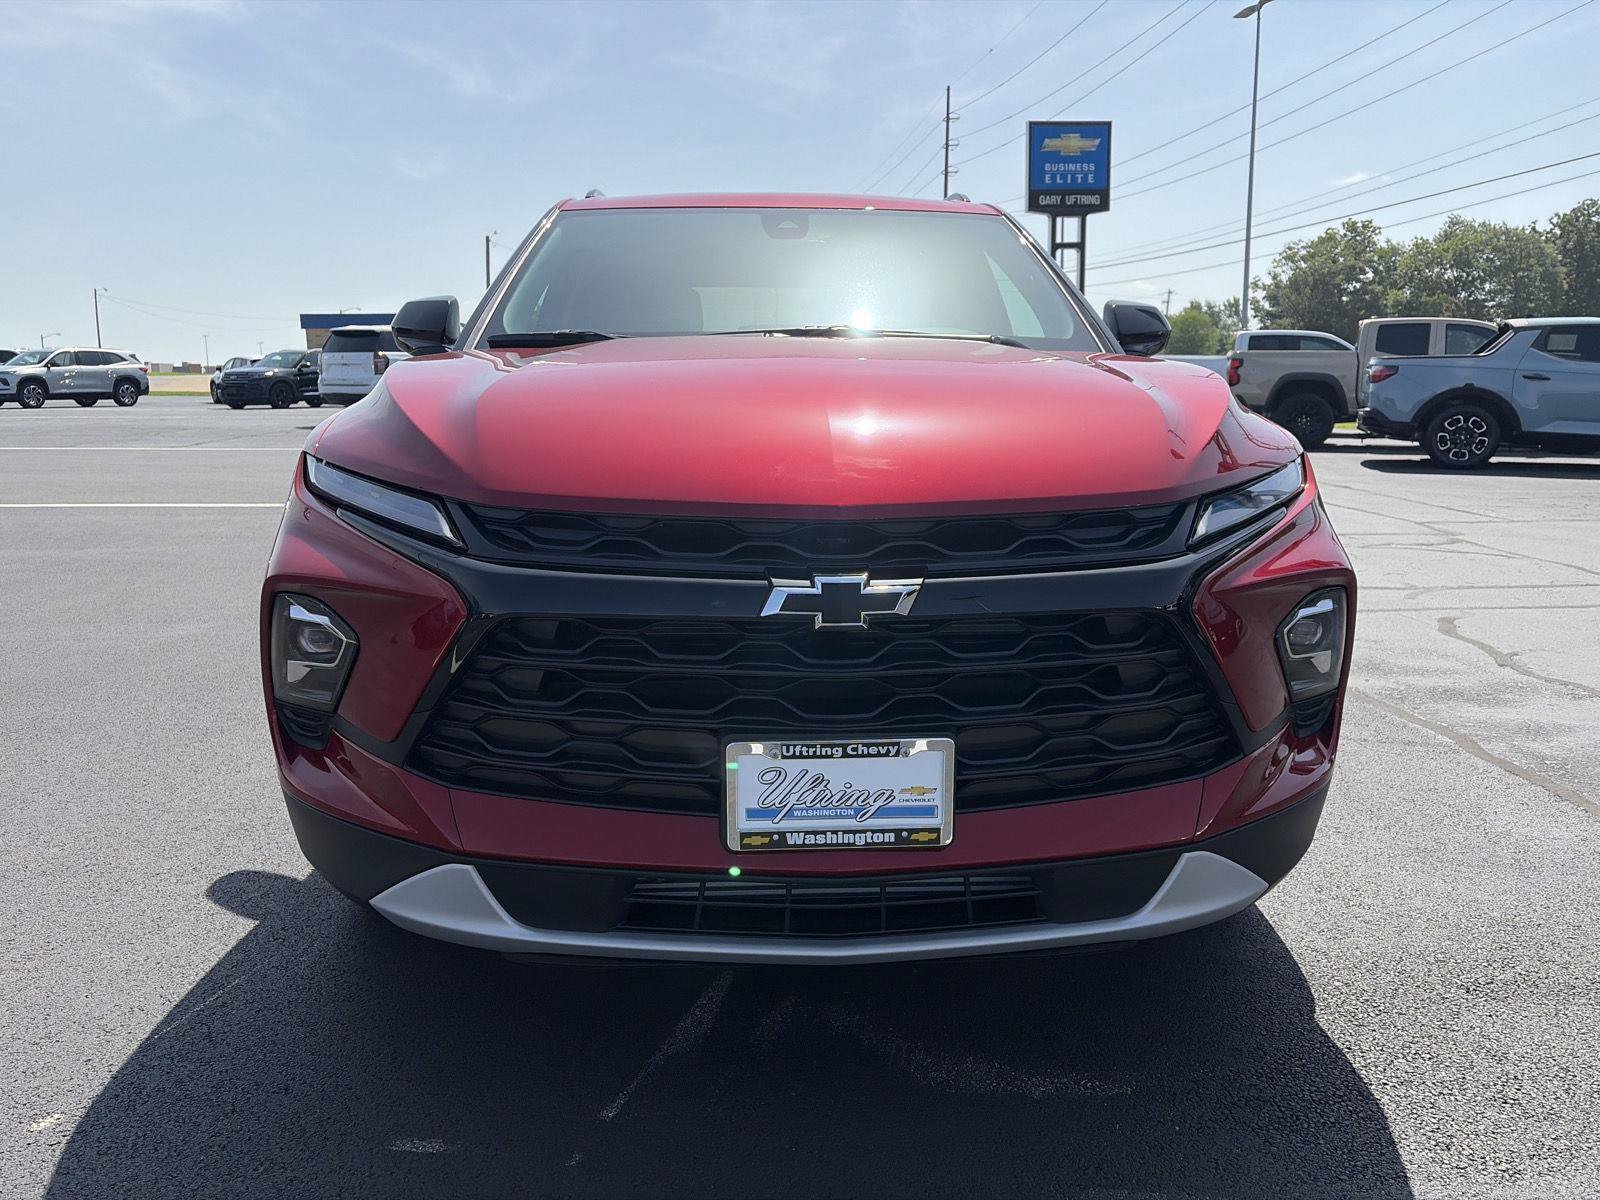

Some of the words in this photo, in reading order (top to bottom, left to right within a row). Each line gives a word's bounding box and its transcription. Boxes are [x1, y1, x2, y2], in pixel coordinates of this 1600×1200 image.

[1044, 163, 1095, 171] BUSINESS
[1045, 174, 1095, 183] ELITE
[1039, 195, 1062, 205] GARY
[1066, 195, 1100, 205] UFTRING
[782, 745, 842, 758] Uftring
[846, 744, 899, 756] Chevy
[757, 766, 896, 824] Uftring
[793, 809, 855, 817] WASHINGTON
[786, 832, 896, 845] Washington
